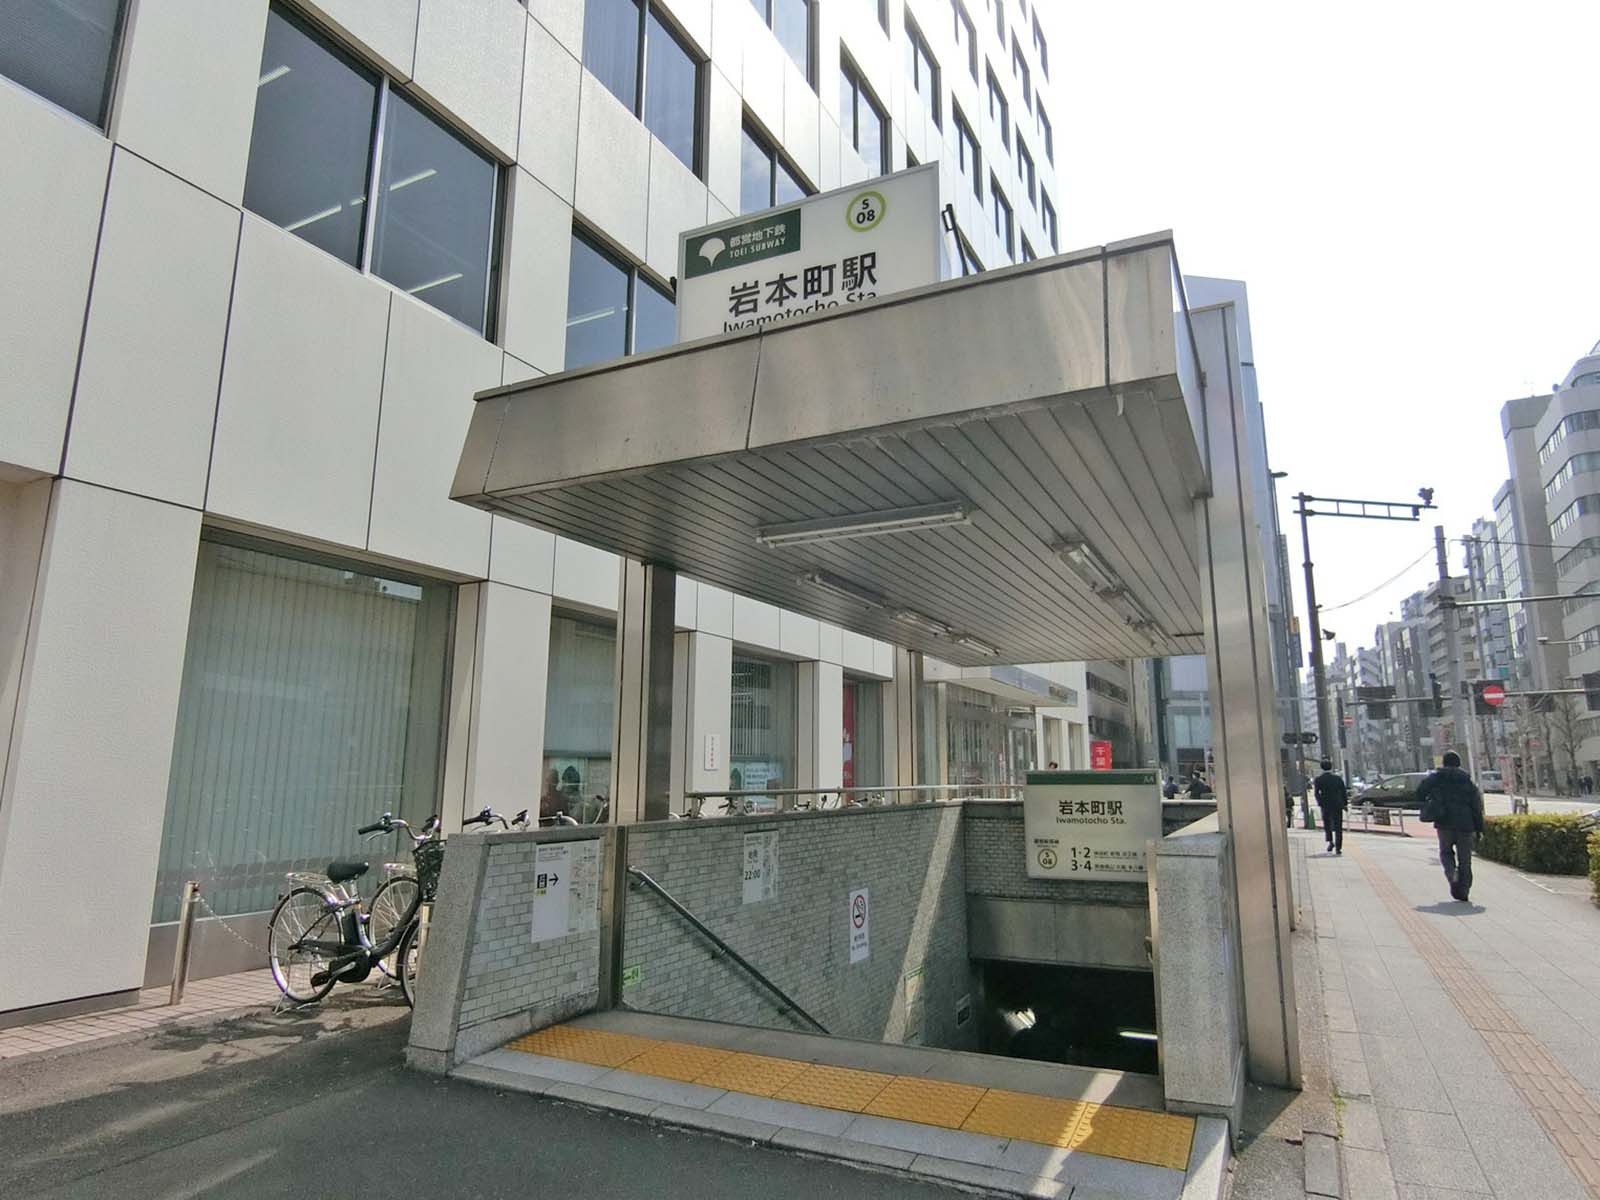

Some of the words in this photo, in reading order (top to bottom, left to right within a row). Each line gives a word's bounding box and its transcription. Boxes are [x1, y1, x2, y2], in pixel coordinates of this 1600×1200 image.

[861, 198, 870, 210] S
[856, 209, 876, 225] 08
[729, 223, 787, 248] 都営地下鉄
[730, 245, 749, 259] TOEI
[750, 237, 786, 254] SUBWAY
[728, 252, 878, 318] 岩本町駅
[1058, 800, 1123, 816] 岩本町駅
[1056, 816, 1109, 825] Iwamotocho
